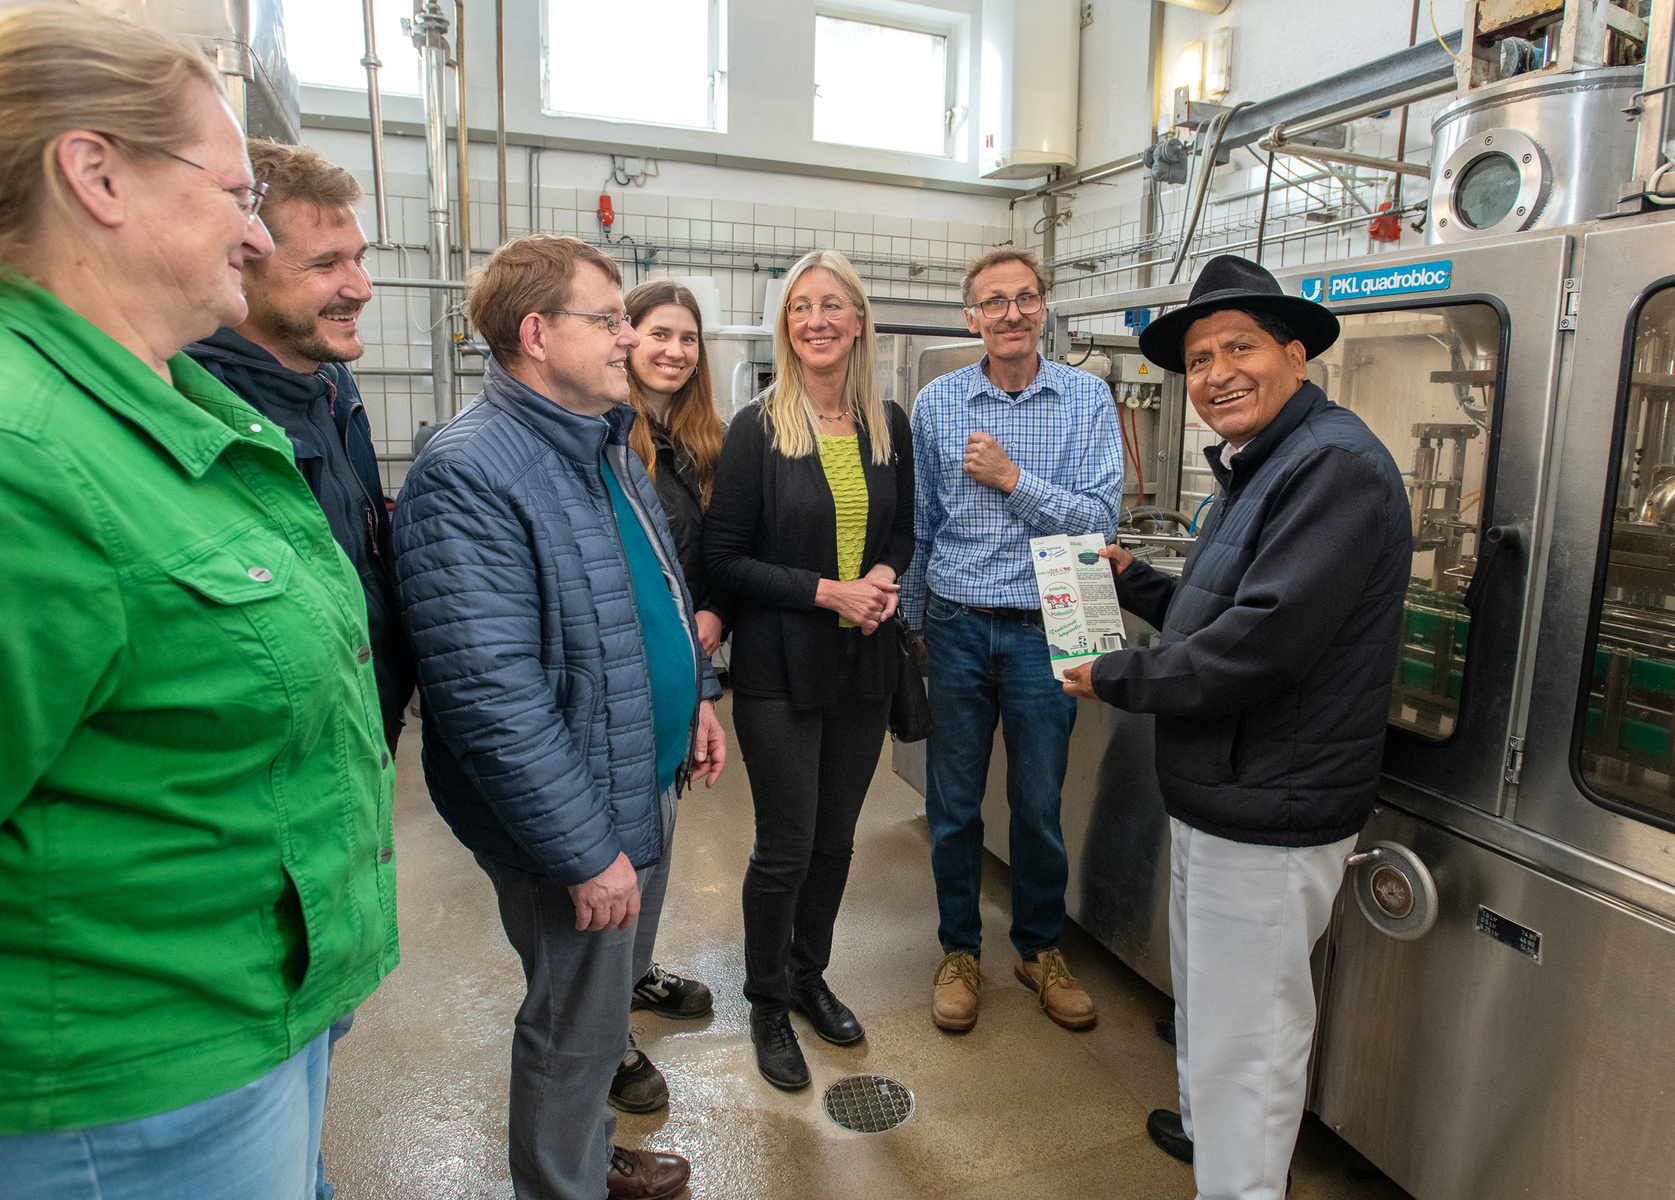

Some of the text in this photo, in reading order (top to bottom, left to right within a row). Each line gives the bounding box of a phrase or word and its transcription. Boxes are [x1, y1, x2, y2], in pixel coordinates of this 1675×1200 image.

[1332, 268, 1446, 295] PKL quadrobloc
[1050, 609, 1075, 617] Vollmilch
